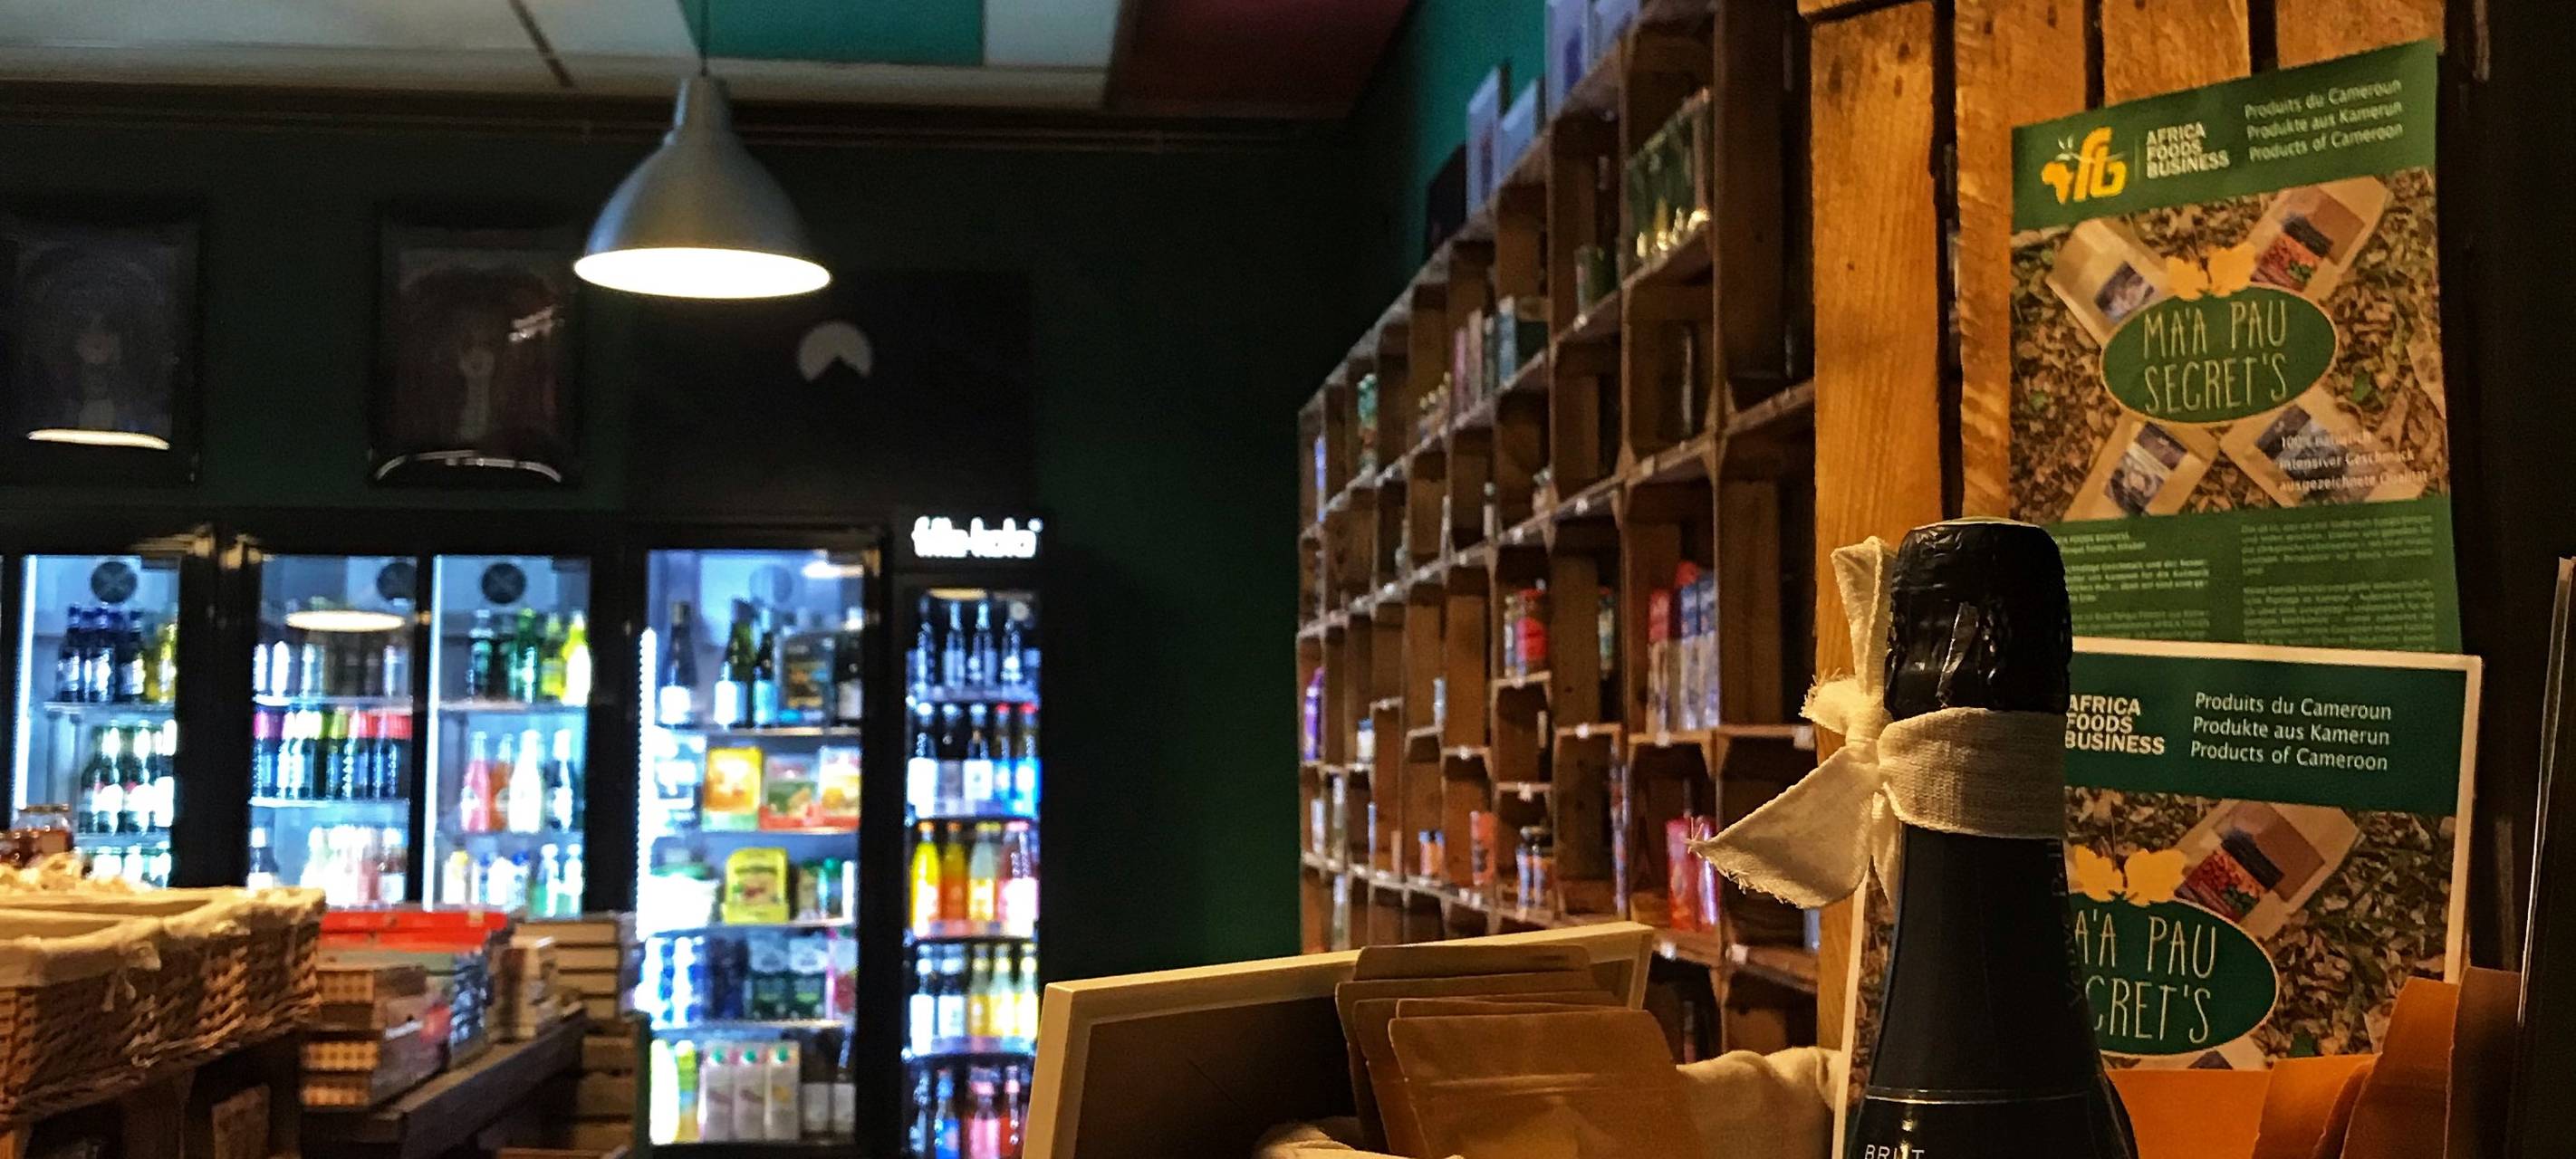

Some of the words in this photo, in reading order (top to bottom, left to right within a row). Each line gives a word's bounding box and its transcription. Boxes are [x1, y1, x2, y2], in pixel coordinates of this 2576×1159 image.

[2244, 100, 2302, 120] Produits
[2306, 92, 2325, 110] du
[2328, 79, 2402, 105] Cameroun
[2146, 121, 2206, 147] AFRICA
[2246, 118, 2308, 141] Produkte
[2312, 113, 2336, 131] aus
[2339, 101, 2403, 124] Kamerun
[2146, 139, 2203, 162] FOODS
[2249, 139, 2309, 162] Products
[2312, 135, 2327, 152] of
[2331, 123, 2404, 149] Cameroon
[2146, 149, 2231, 179] BUSINESS
[2144, 306, 2207, 359] MA'A
[2230, 299, 2287, 351] PAU
[2144, 352, 2287, 414] SECRET'S
[2069, 694, 2141, 716] AFRICA
[2195, 692, 2264, 714] Produits
[2271, 696, 2294, 715] du
[2301, 698, 2392, 721] Cameroun
[2066, 712, 2134, 734] FOODS
[2193, 716, 2269, 739] Produkte
[2273, 723, 2304, 741] aus
[2311, 723, 2390, 746] Kamerun
[2064, 730, 2166, 756] BUSINESS
[2190, 740, 2264, 763] Products
[2271, 745, 2292, 765] of
[2296, 747, 2389, 771] Cameroon
[2074, 908, 2117, 967] A'A
[2147, 915, 2216, 979] PAU
[2085, 974, 2211, 1043] CRET'S
